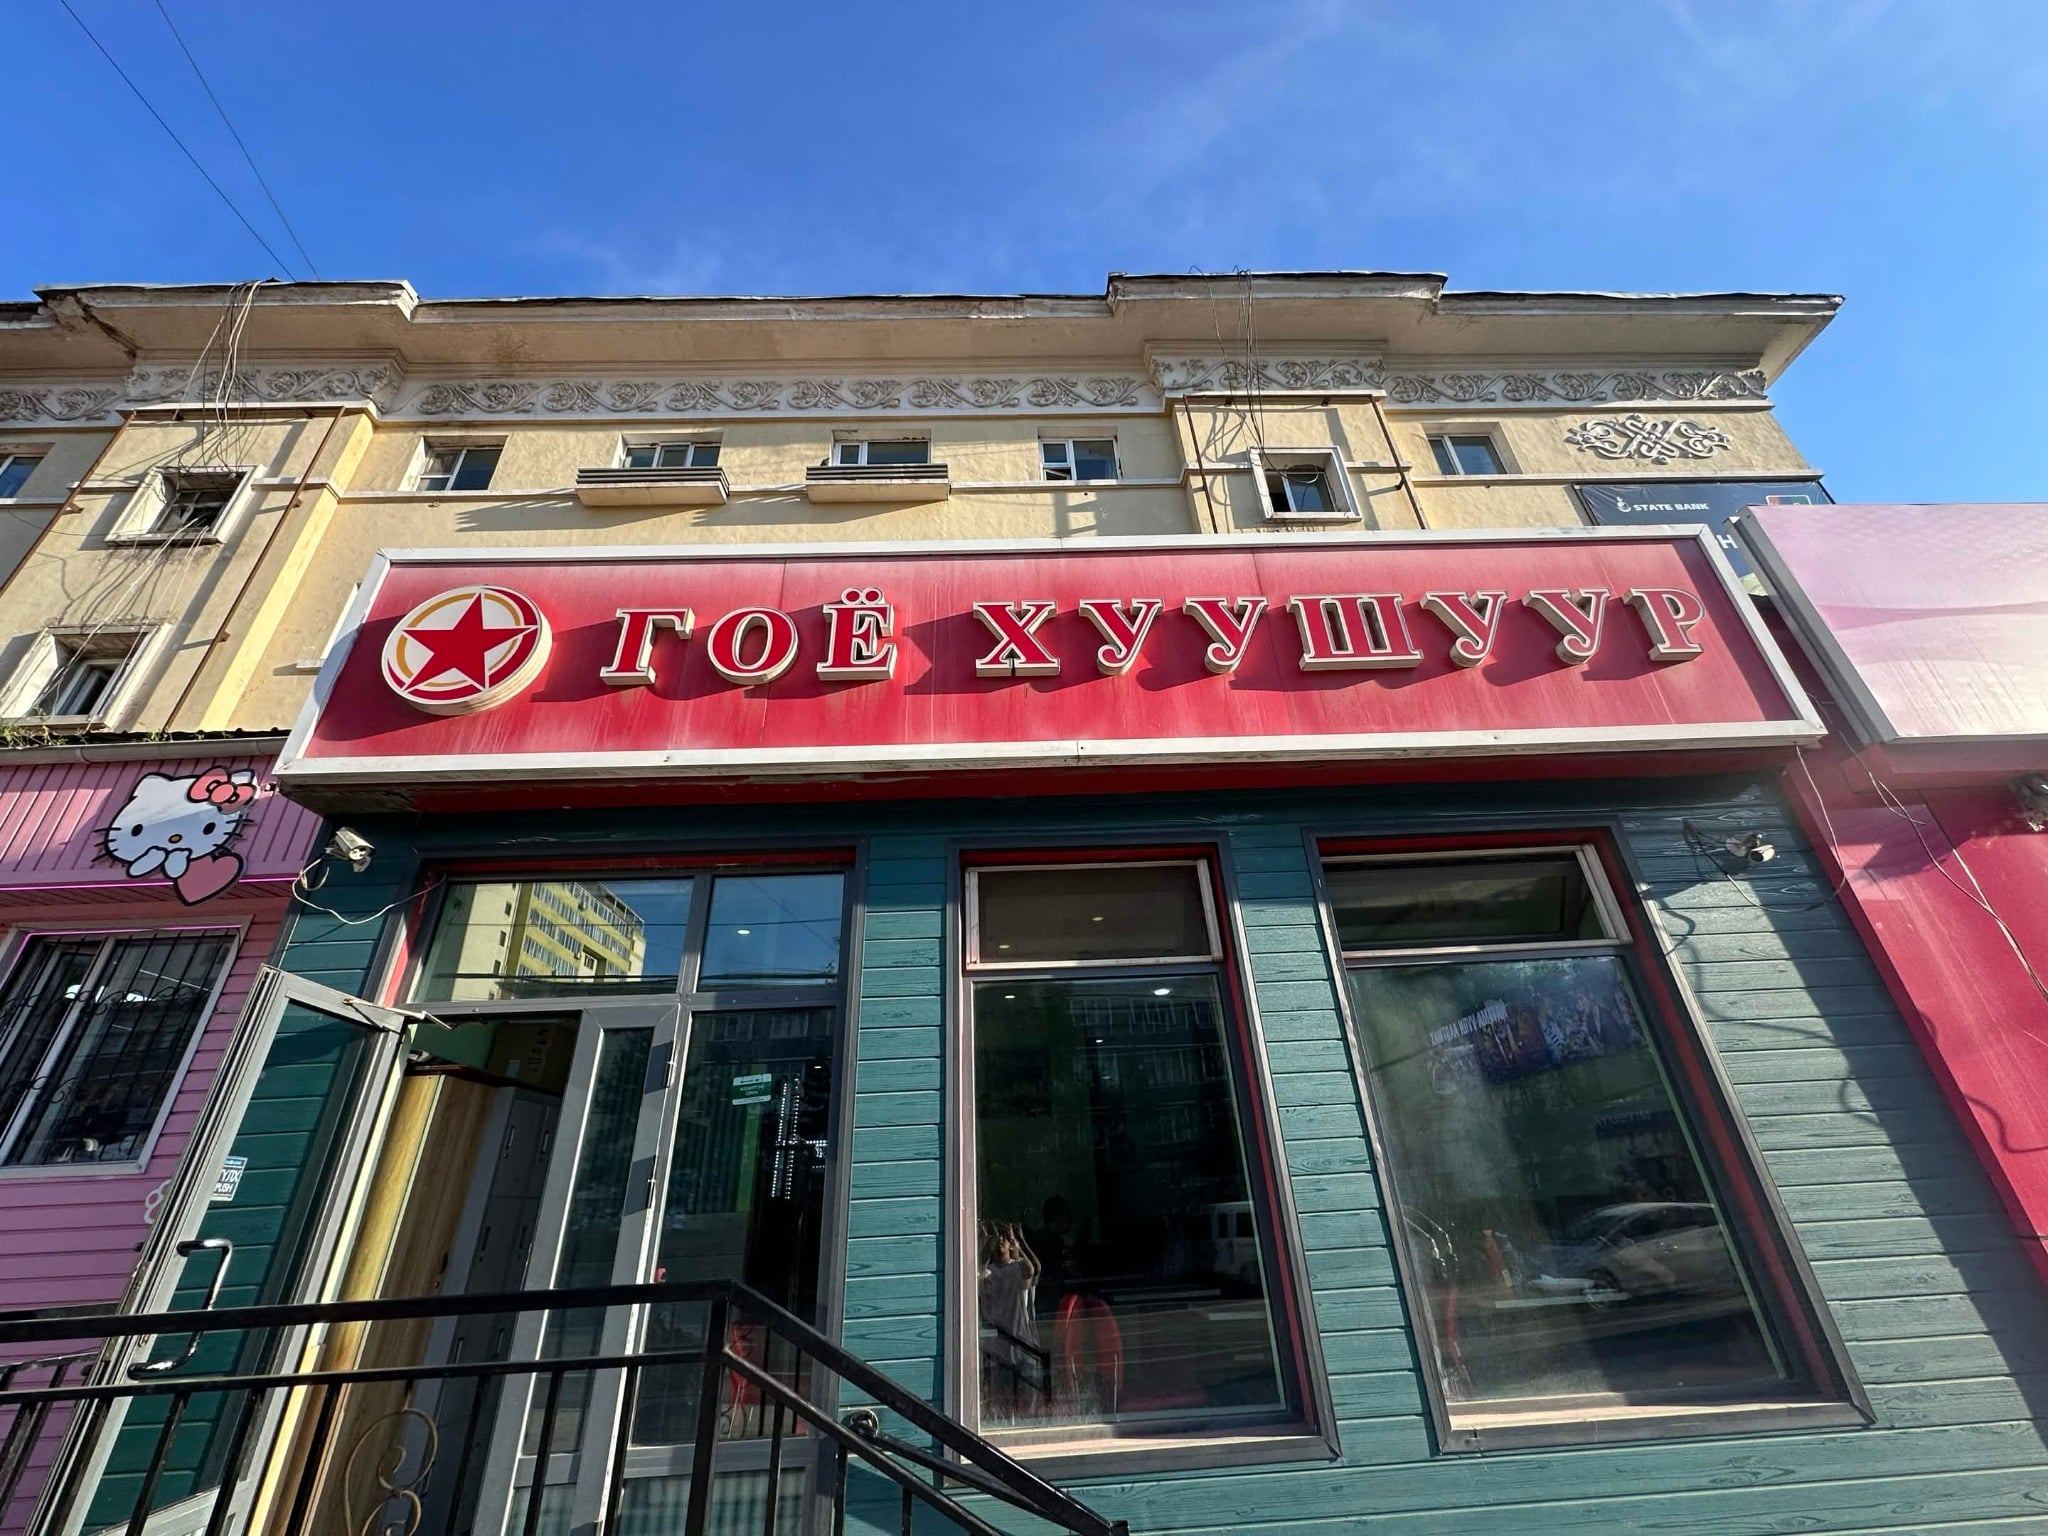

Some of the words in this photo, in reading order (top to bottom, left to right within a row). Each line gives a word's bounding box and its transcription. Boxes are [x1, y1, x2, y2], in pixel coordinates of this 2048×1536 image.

[1633, 503, 1673, 511] STATE
[600, 586, 898, 685] ГОЁ
[973, 586, 1706, 677] ХУУШУУР
